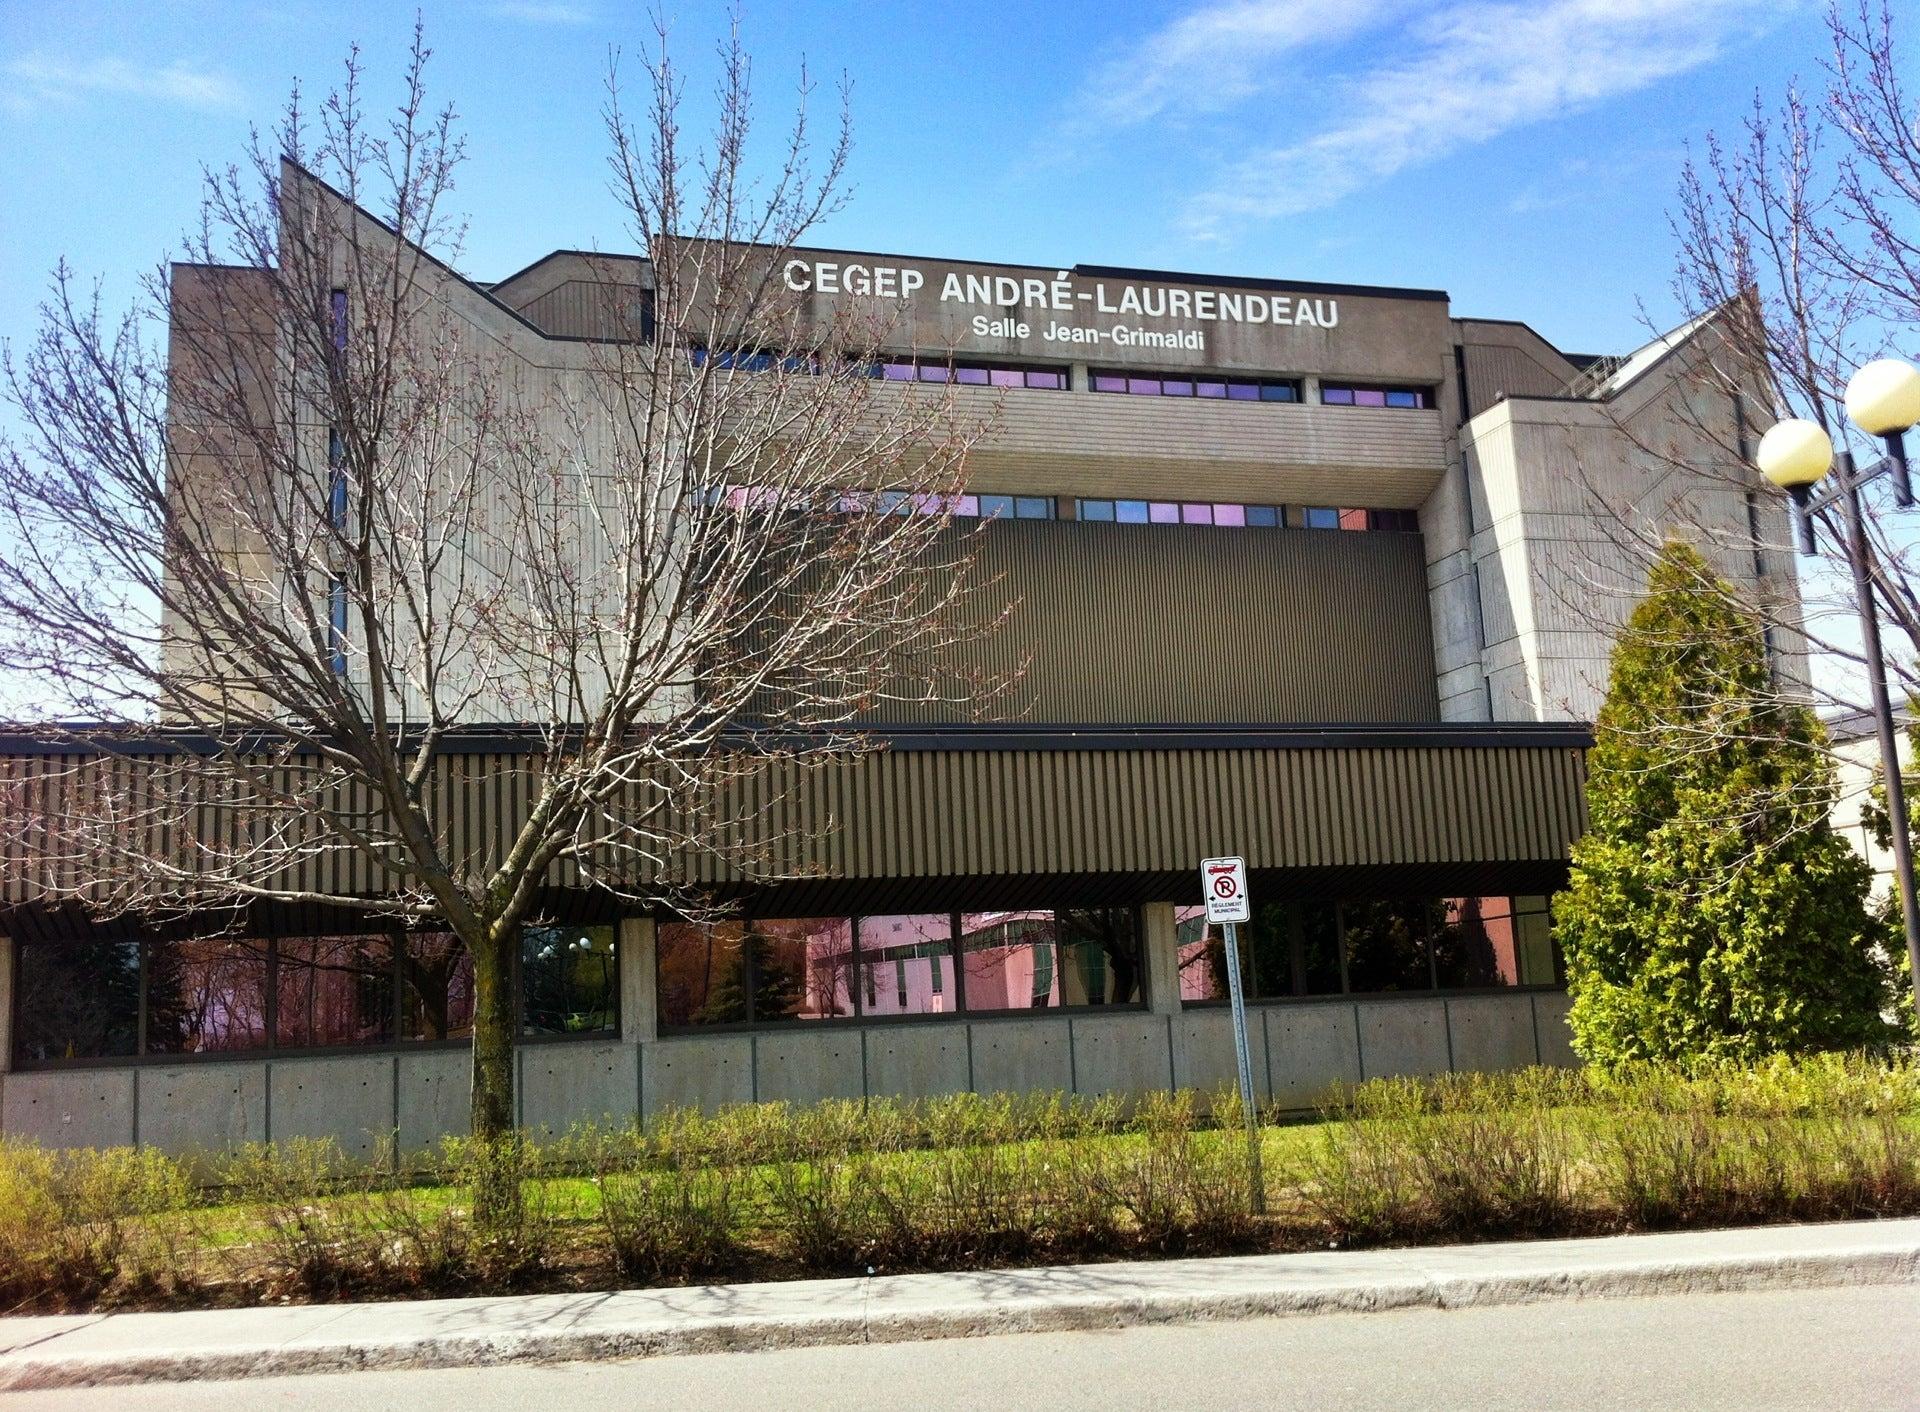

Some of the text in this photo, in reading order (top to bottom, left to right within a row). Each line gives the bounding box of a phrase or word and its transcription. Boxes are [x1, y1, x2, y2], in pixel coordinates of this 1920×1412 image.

[783, 259, 1338, 329] CEGEP ANDRÉ-LAURENDEAU
[972, 316, 1205, 350] Salle Jean-Grimaldi
